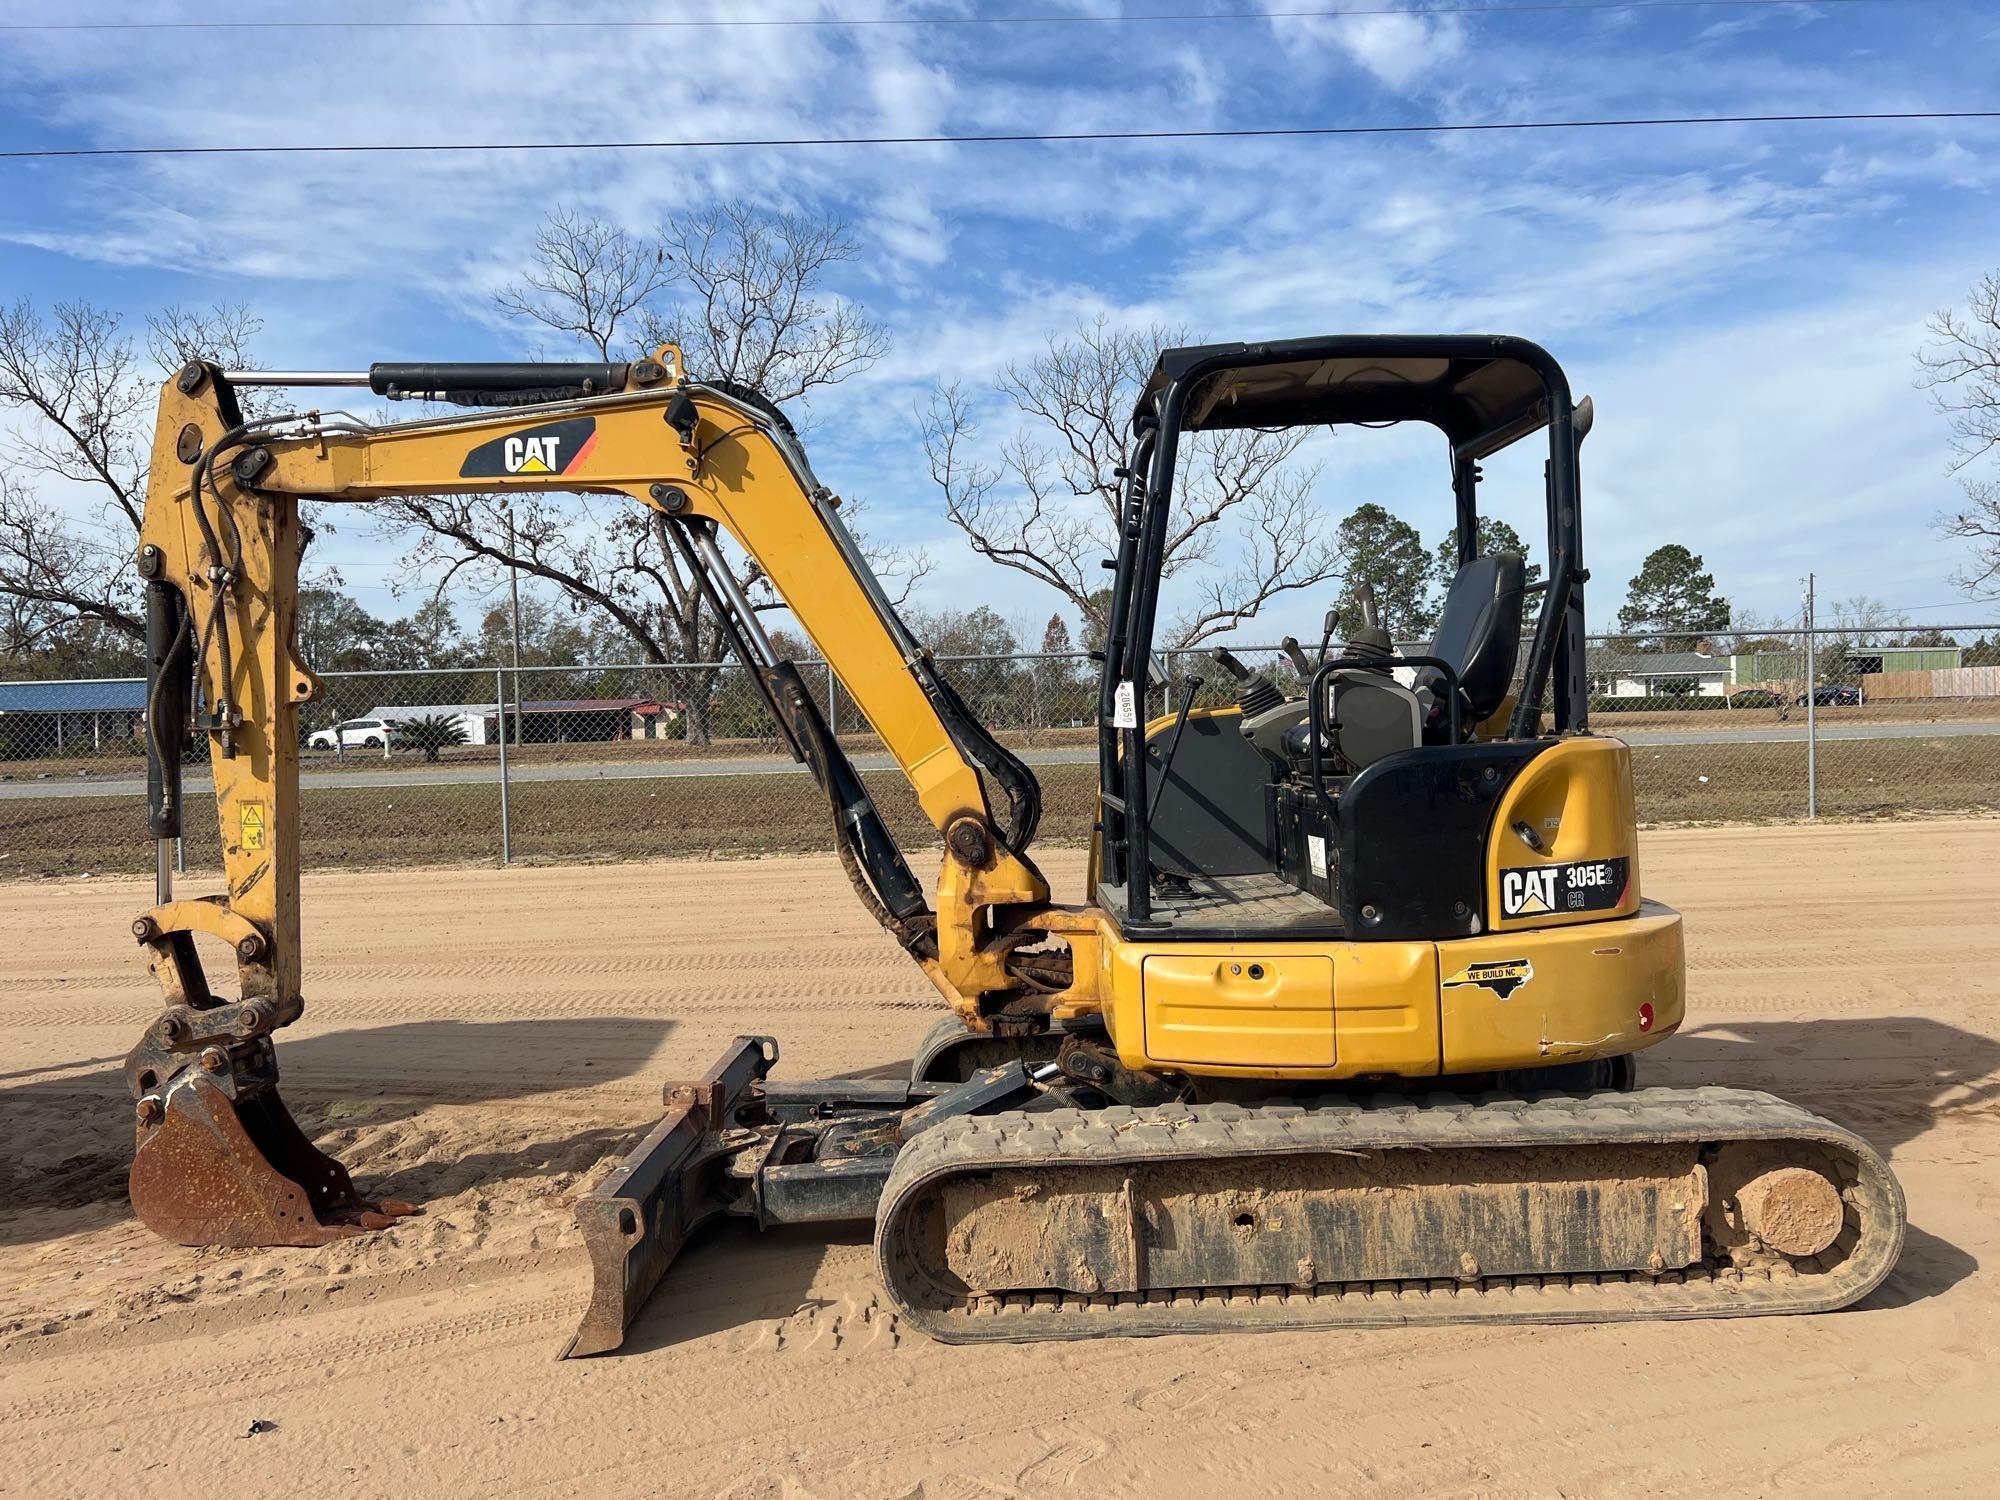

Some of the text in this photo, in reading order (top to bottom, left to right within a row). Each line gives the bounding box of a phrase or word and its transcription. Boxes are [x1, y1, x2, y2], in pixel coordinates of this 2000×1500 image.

[505, 437, 560, 472] CAT
[1131, 474, 1145, 505] 1177
[1121, 692, 1132, 723] 206550
[1504, 869, 1558, 914] CAT
[1568, 891, 1584, 908] CR
[1482, 970, 1503, 979] BUILD
[1505, 968, 1515, 976] NC
